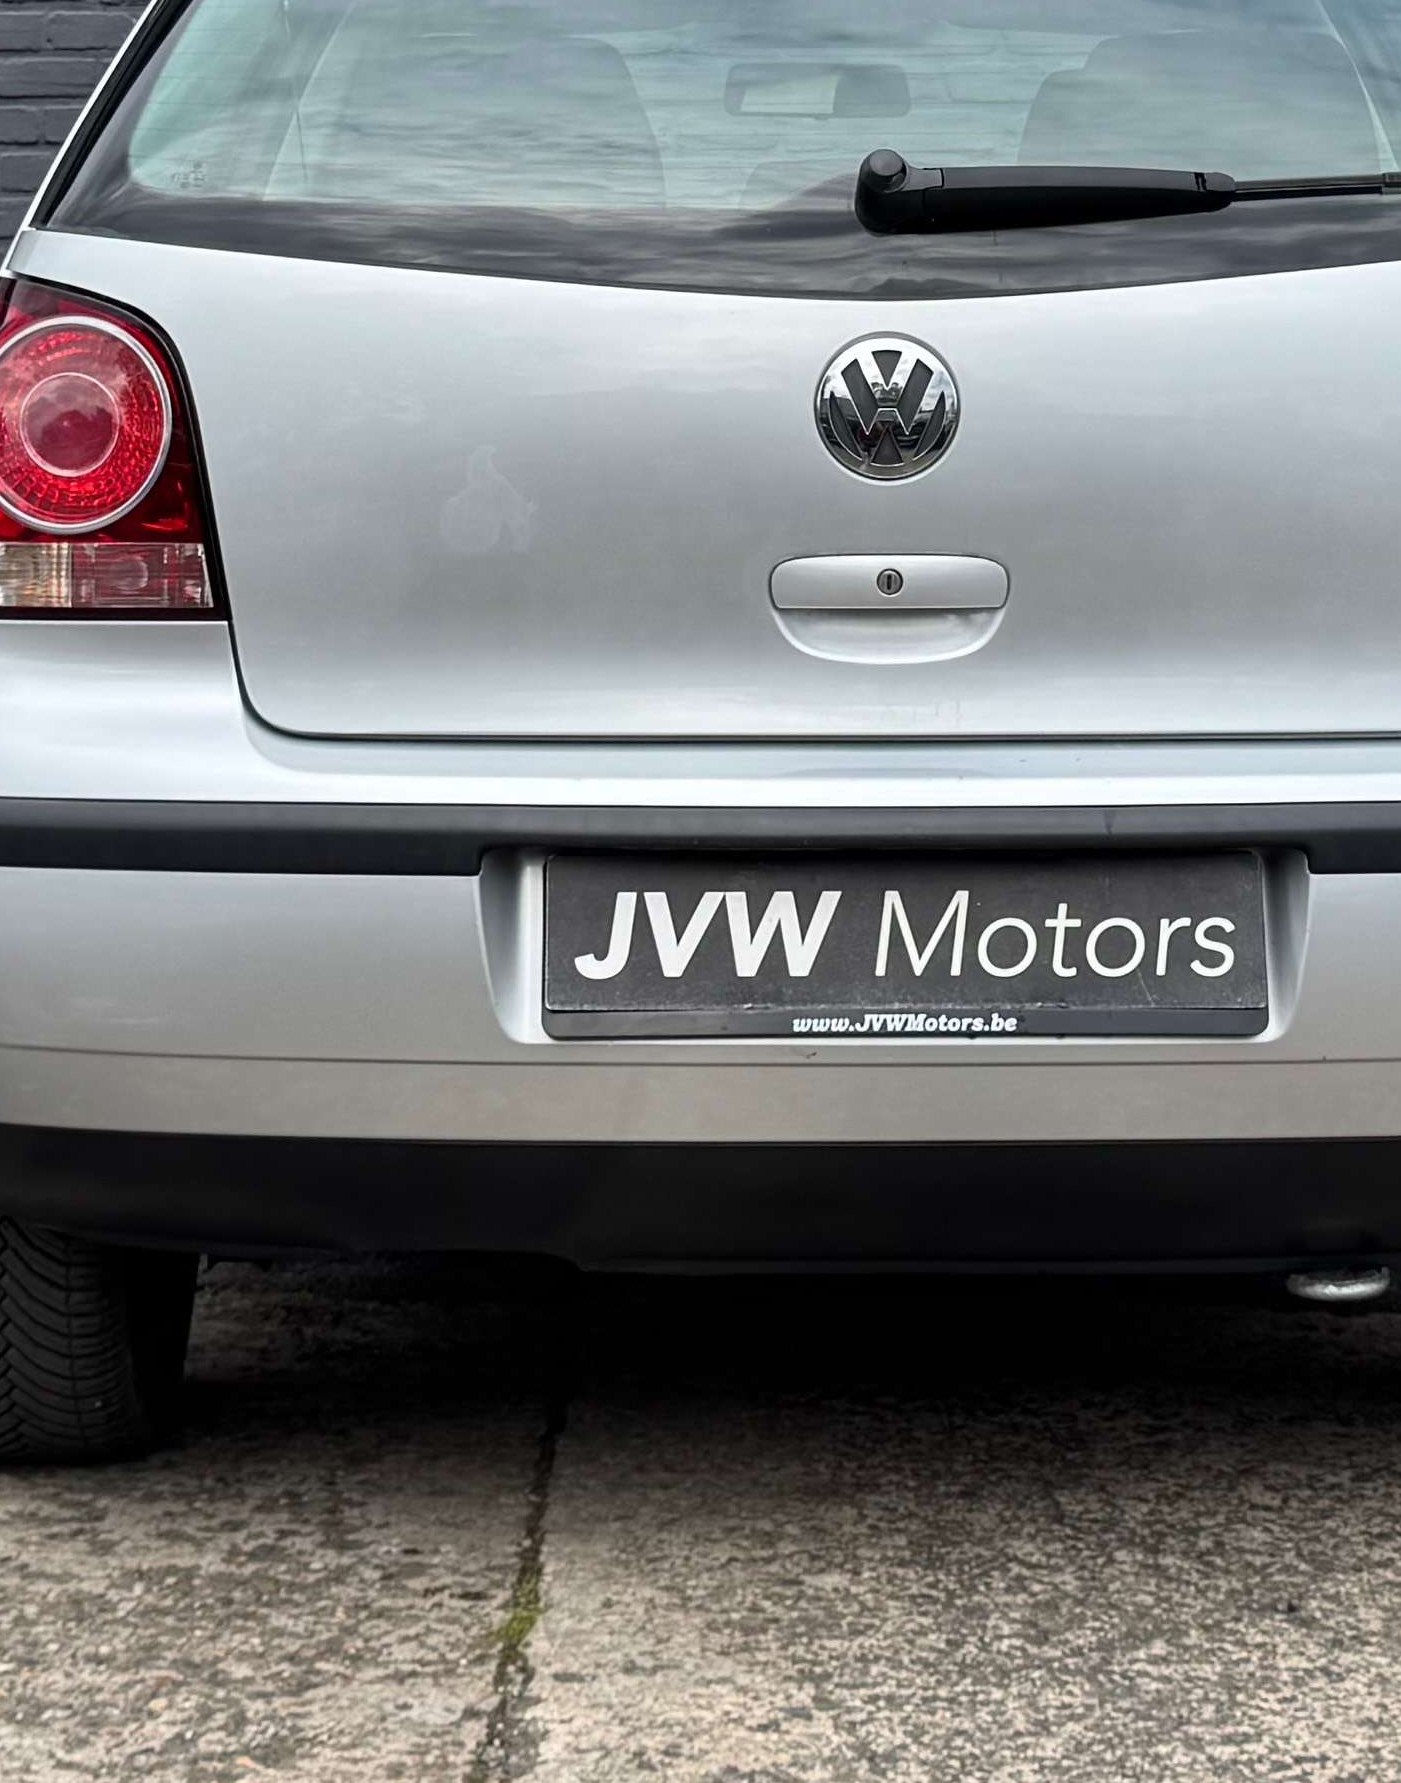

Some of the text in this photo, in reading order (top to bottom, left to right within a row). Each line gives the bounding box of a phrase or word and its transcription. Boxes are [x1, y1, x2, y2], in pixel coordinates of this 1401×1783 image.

[573, 889, 1237, 981] JVW Motors
[791, 1012, 1018, 1034] www.JVWMotors.be
